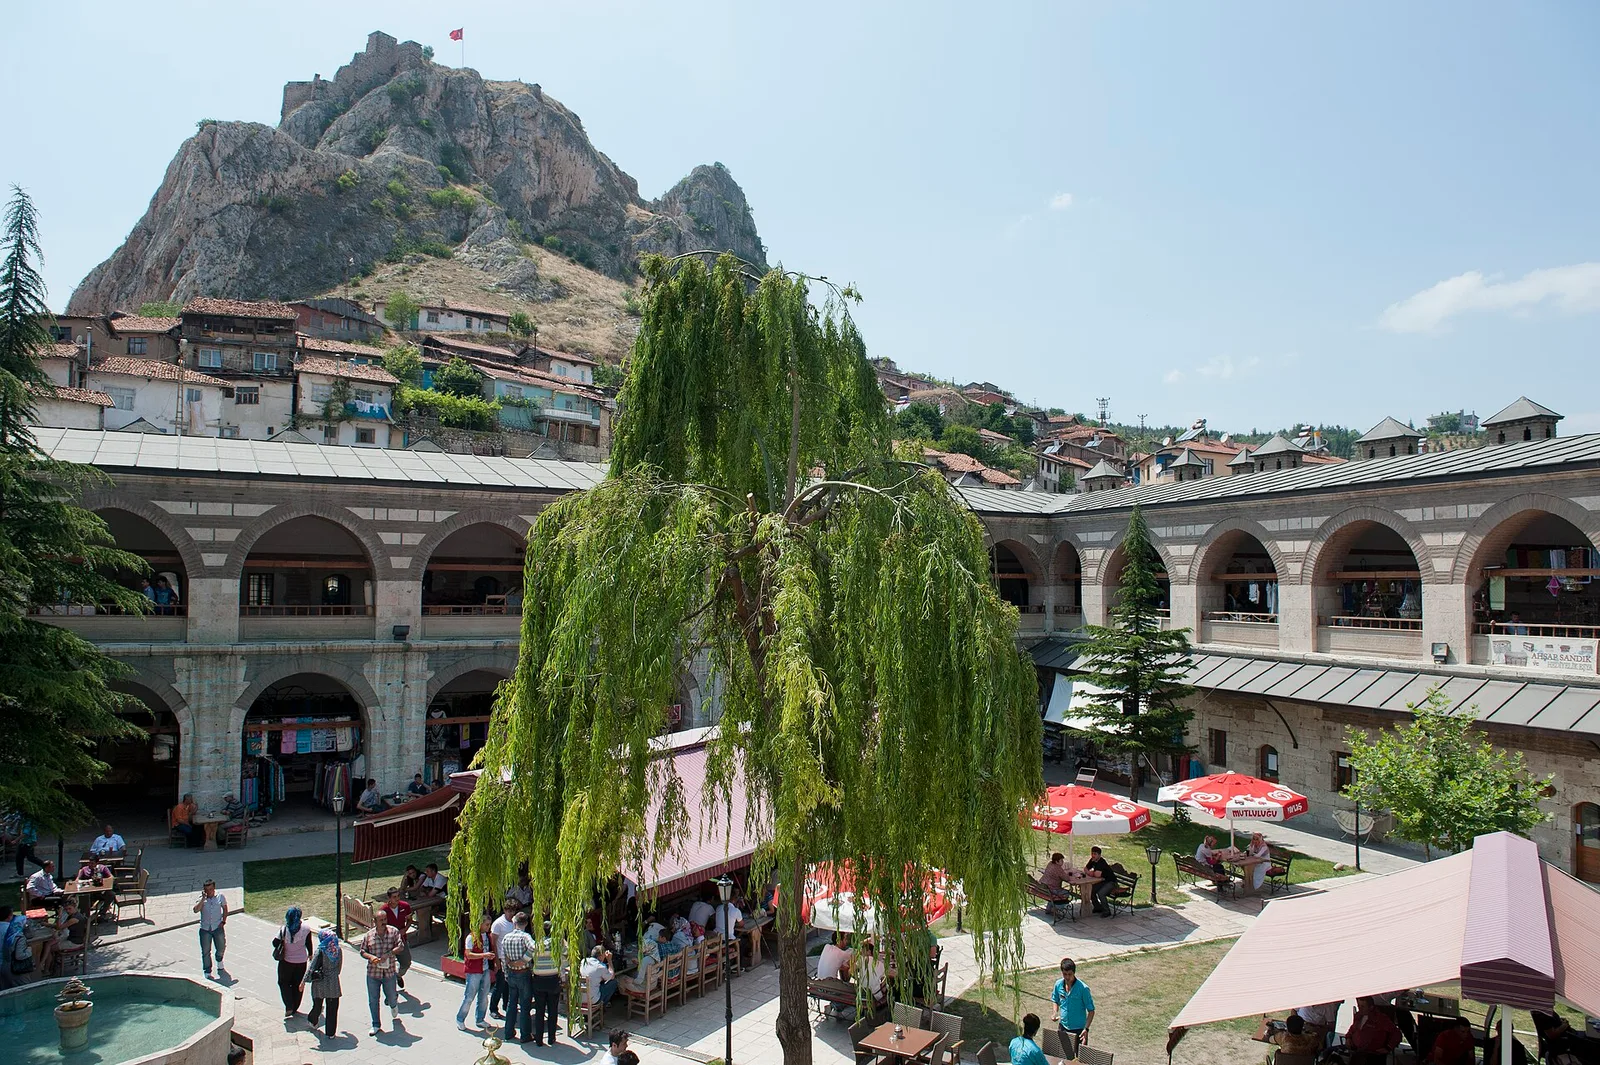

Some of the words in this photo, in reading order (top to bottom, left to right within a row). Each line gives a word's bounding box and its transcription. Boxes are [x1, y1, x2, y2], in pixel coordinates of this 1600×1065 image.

[1531, 653, 1558, 661] AHŞAP
[1560, 654, 1591, 662] SANDIK
[1232, 808, 1278, 818] MUTLULUĞU
